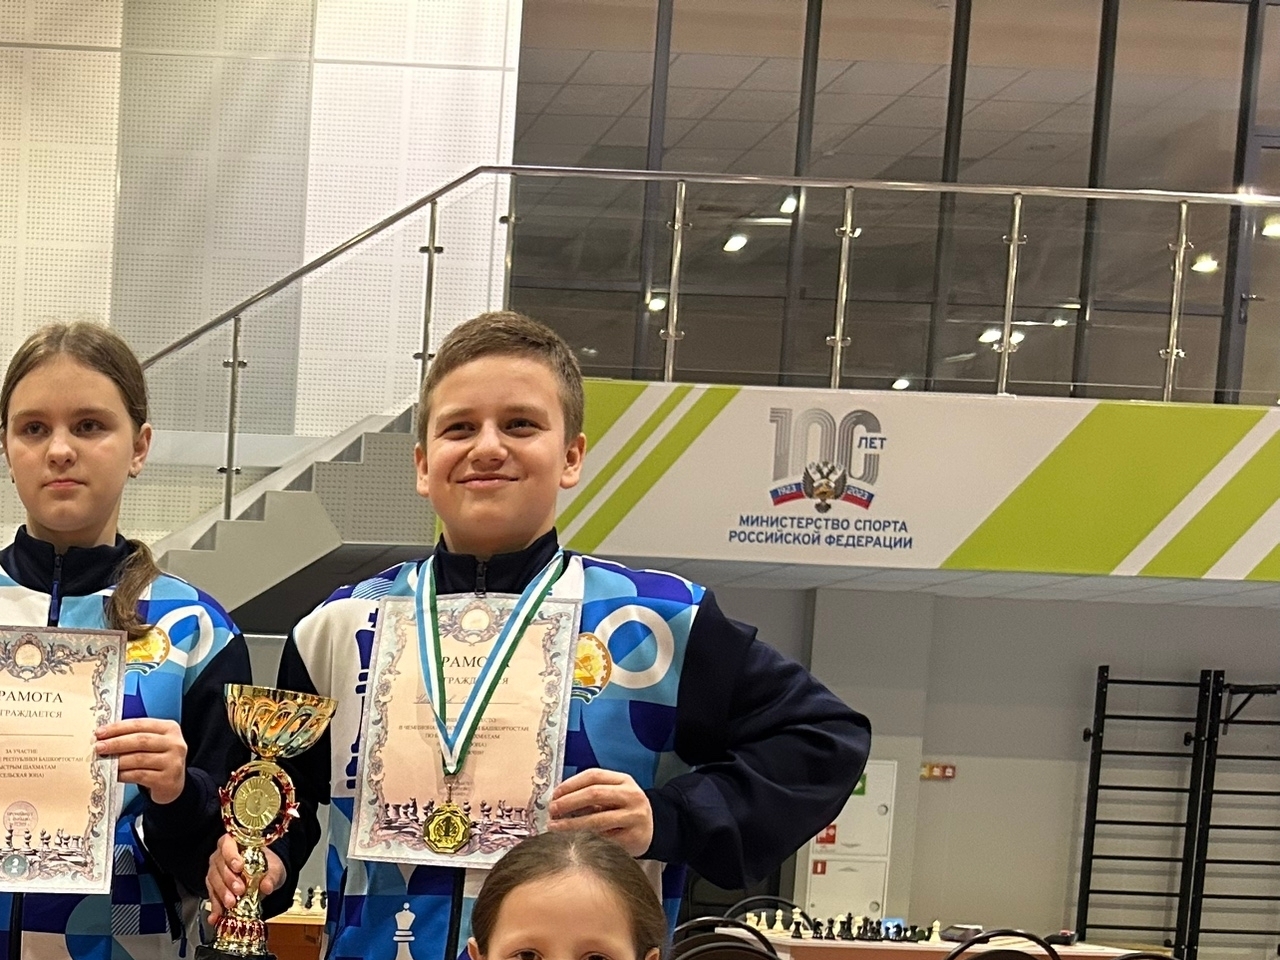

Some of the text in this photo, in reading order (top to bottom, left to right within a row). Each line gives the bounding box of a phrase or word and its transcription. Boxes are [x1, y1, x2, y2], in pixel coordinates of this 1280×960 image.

[857, 436, 887, 450] ЛЕТ
[777, 484, 797, 496] 1923
[847, 485, 868, 500] 2023
[738, 515, 908, 533] МИНИСТЕРСТВО СПОРТА
[729, 529, 913, 550] РОССИЙСКОЙ ФЕДЕРАЦИИ
